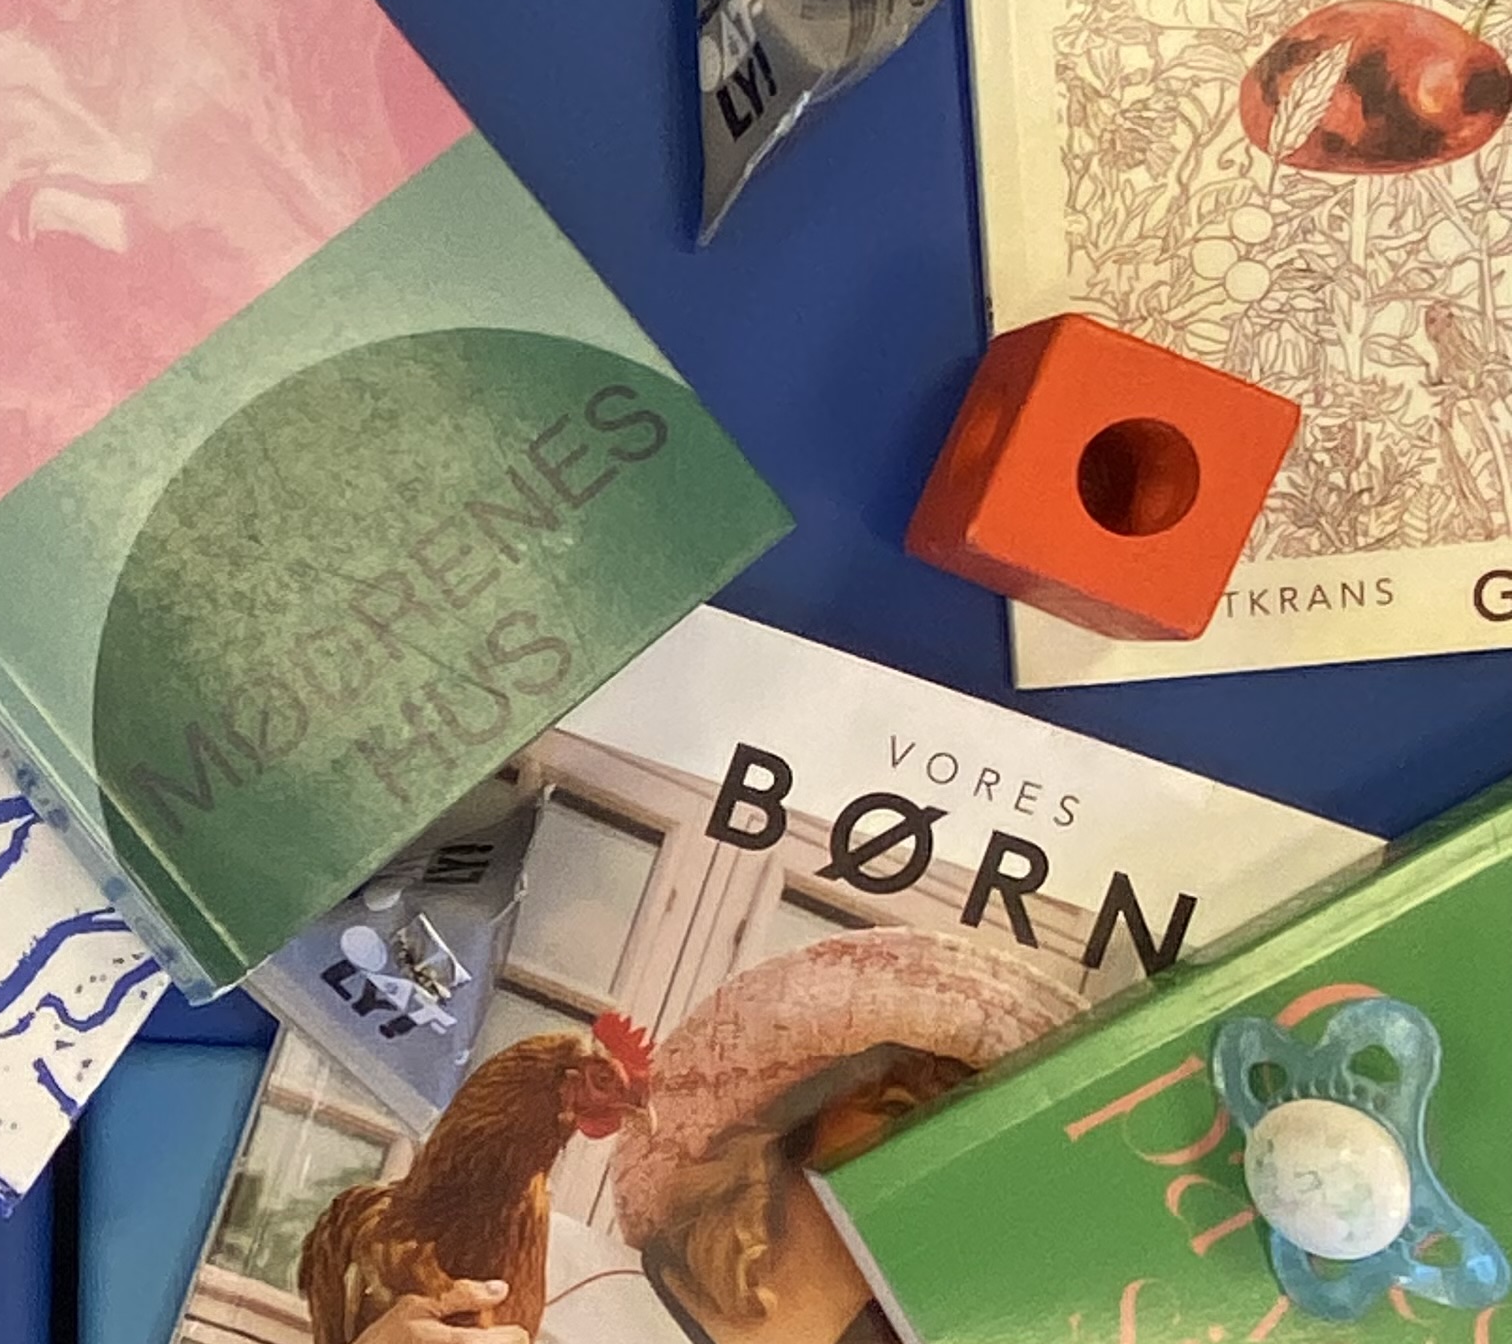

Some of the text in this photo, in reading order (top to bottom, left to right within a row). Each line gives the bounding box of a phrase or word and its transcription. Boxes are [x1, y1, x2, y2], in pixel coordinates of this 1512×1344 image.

[716, 40, 778, 142] LY!
[127, 383, 669, 838] MØDRENES
[1224, 577, 1394, 618] TKRANS
[354, 609, 573, 806] HUS
[890, 734, 1081, 828] VORES
[705, 741, 1198, 978] BØRN
[320, 959, 418, 1040] LY!
